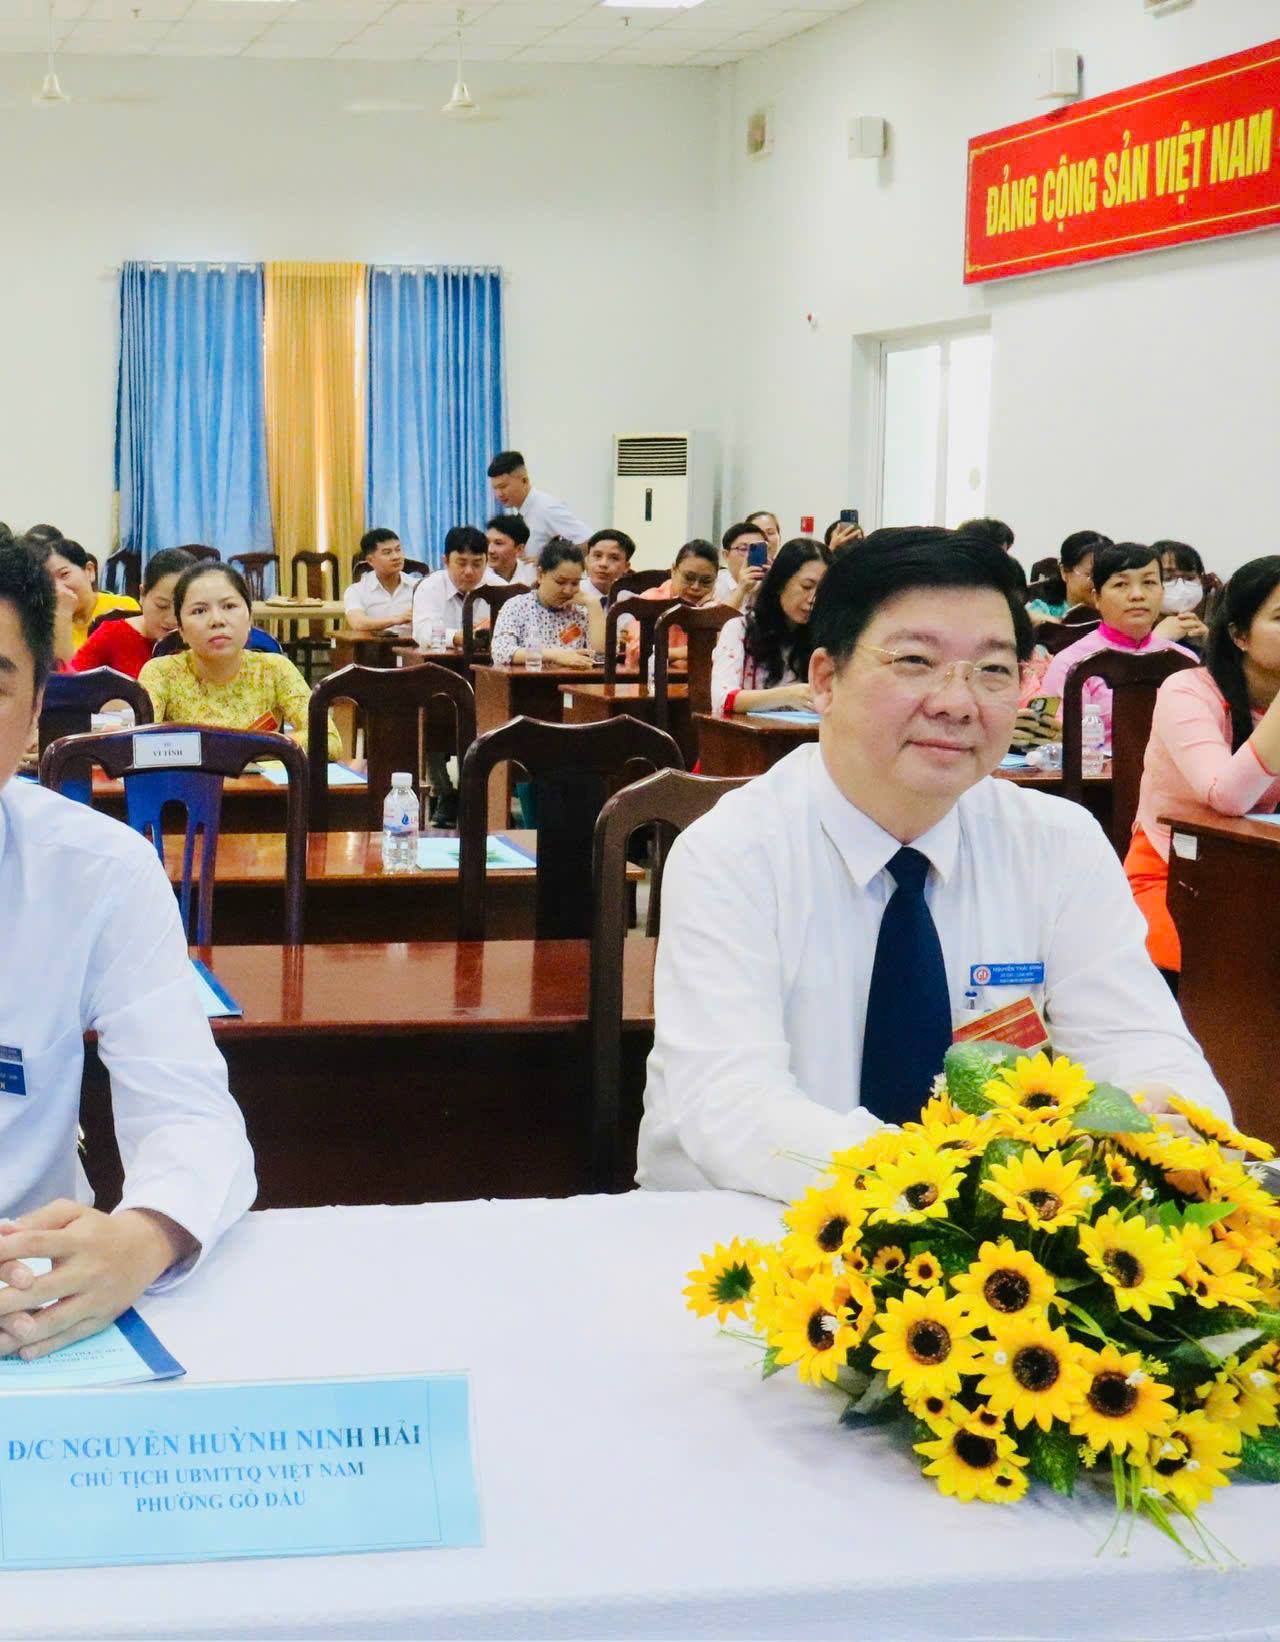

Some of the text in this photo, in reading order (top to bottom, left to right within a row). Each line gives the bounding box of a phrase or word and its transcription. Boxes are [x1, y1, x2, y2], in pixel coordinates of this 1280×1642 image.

[985, 108, 1274, 237] ĐẢNG CỘNG SẢN VIỆT NAM
[189, 1426, 287, 1454] HUỲNH
[296, 1427, 364, 1450] NINH
[373, 1419, 421, 1448] HẢI
[120, 1469, 169, 1488] TỊCH
[175, 1464, 262, 1485] UBMTTQ
[267, 1460, 313, 1483] VIỆT
[320, 1460, 364, 1477] NAM
